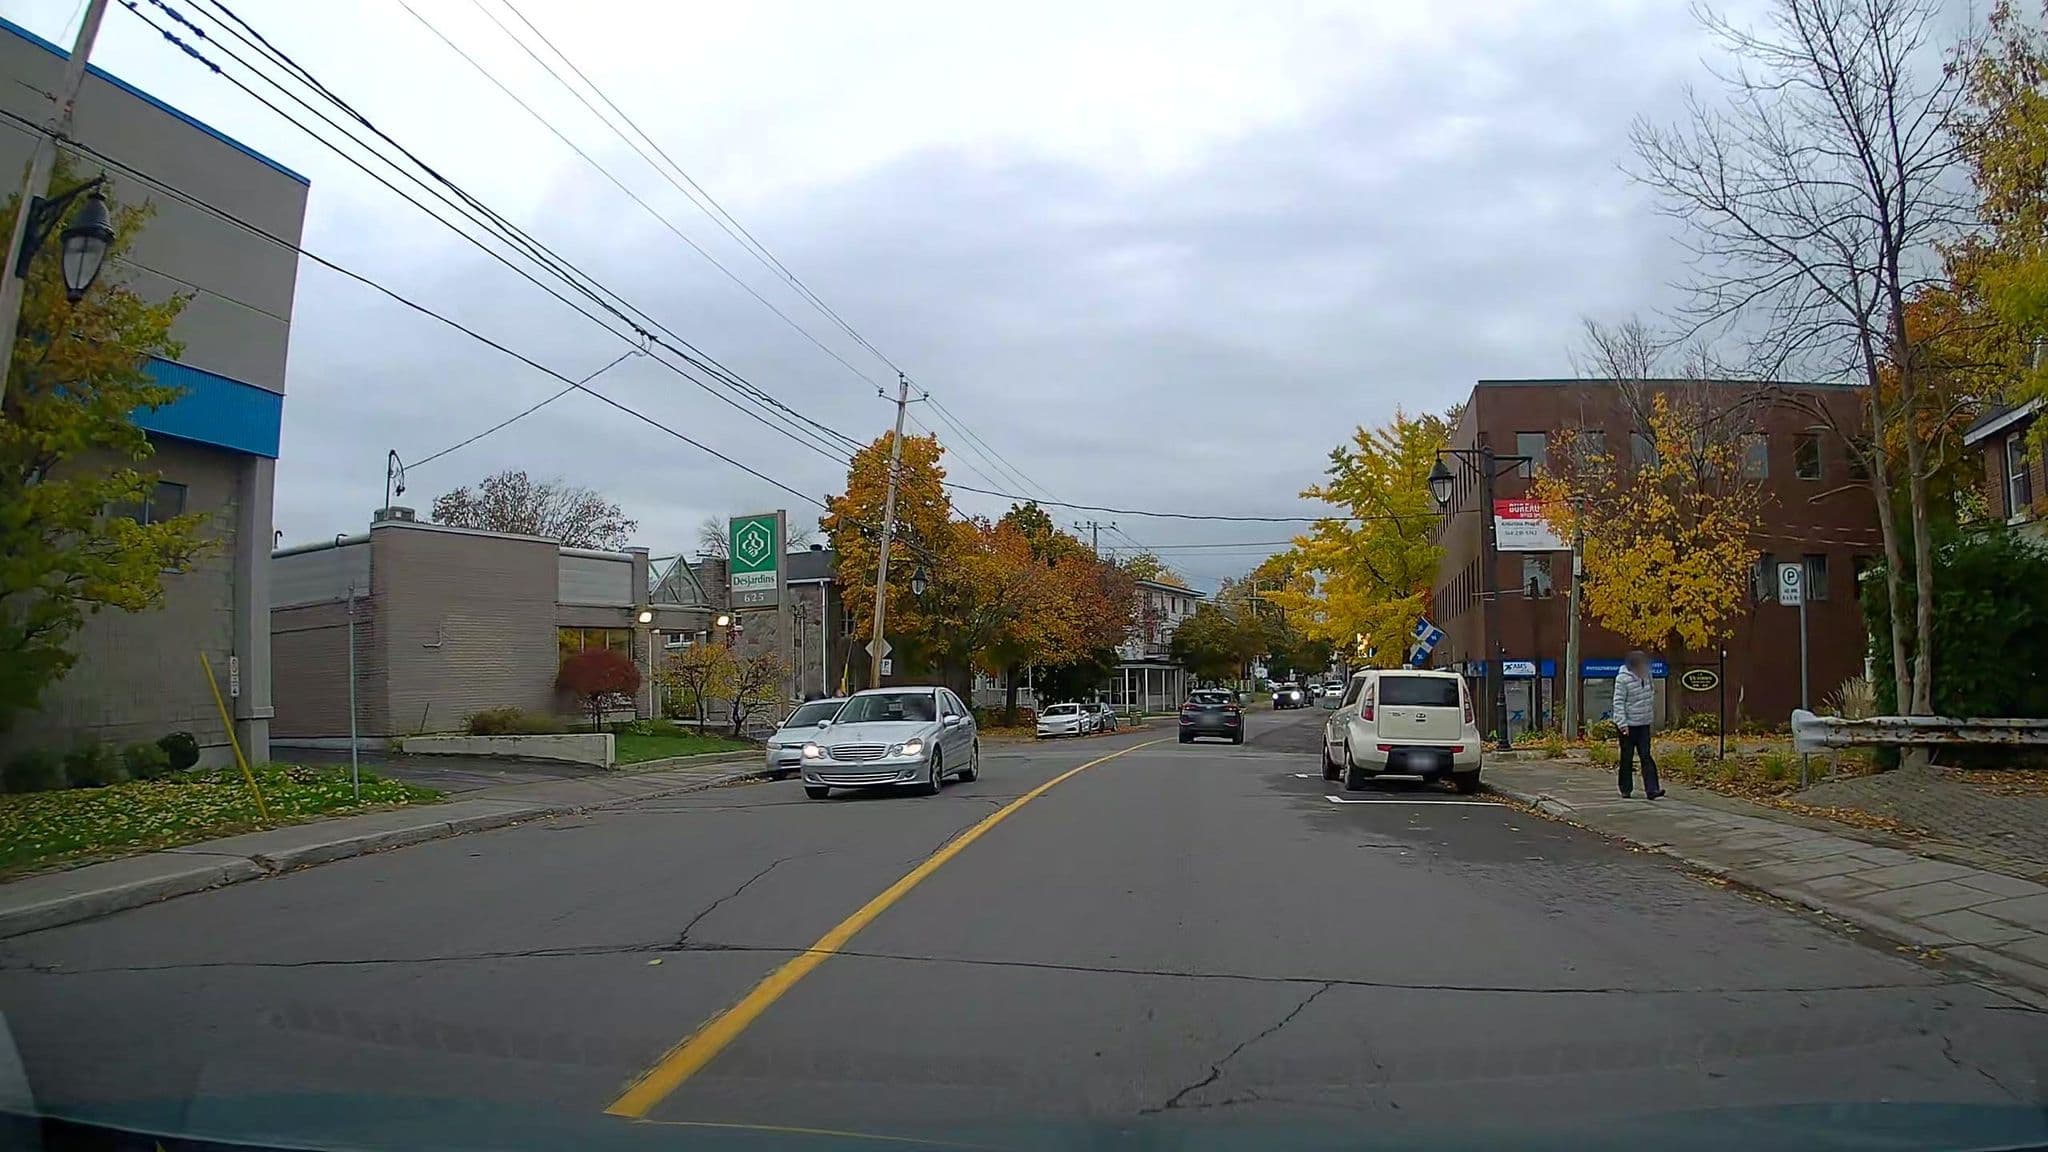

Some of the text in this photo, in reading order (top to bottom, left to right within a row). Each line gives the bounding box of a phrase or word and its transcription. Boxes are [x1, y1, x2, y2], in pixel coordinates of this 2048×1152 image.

[733, 575, 775, 587] Desjardins
[1788, 571, 1795, 581] P
[744, 593, 764, 603] 625
